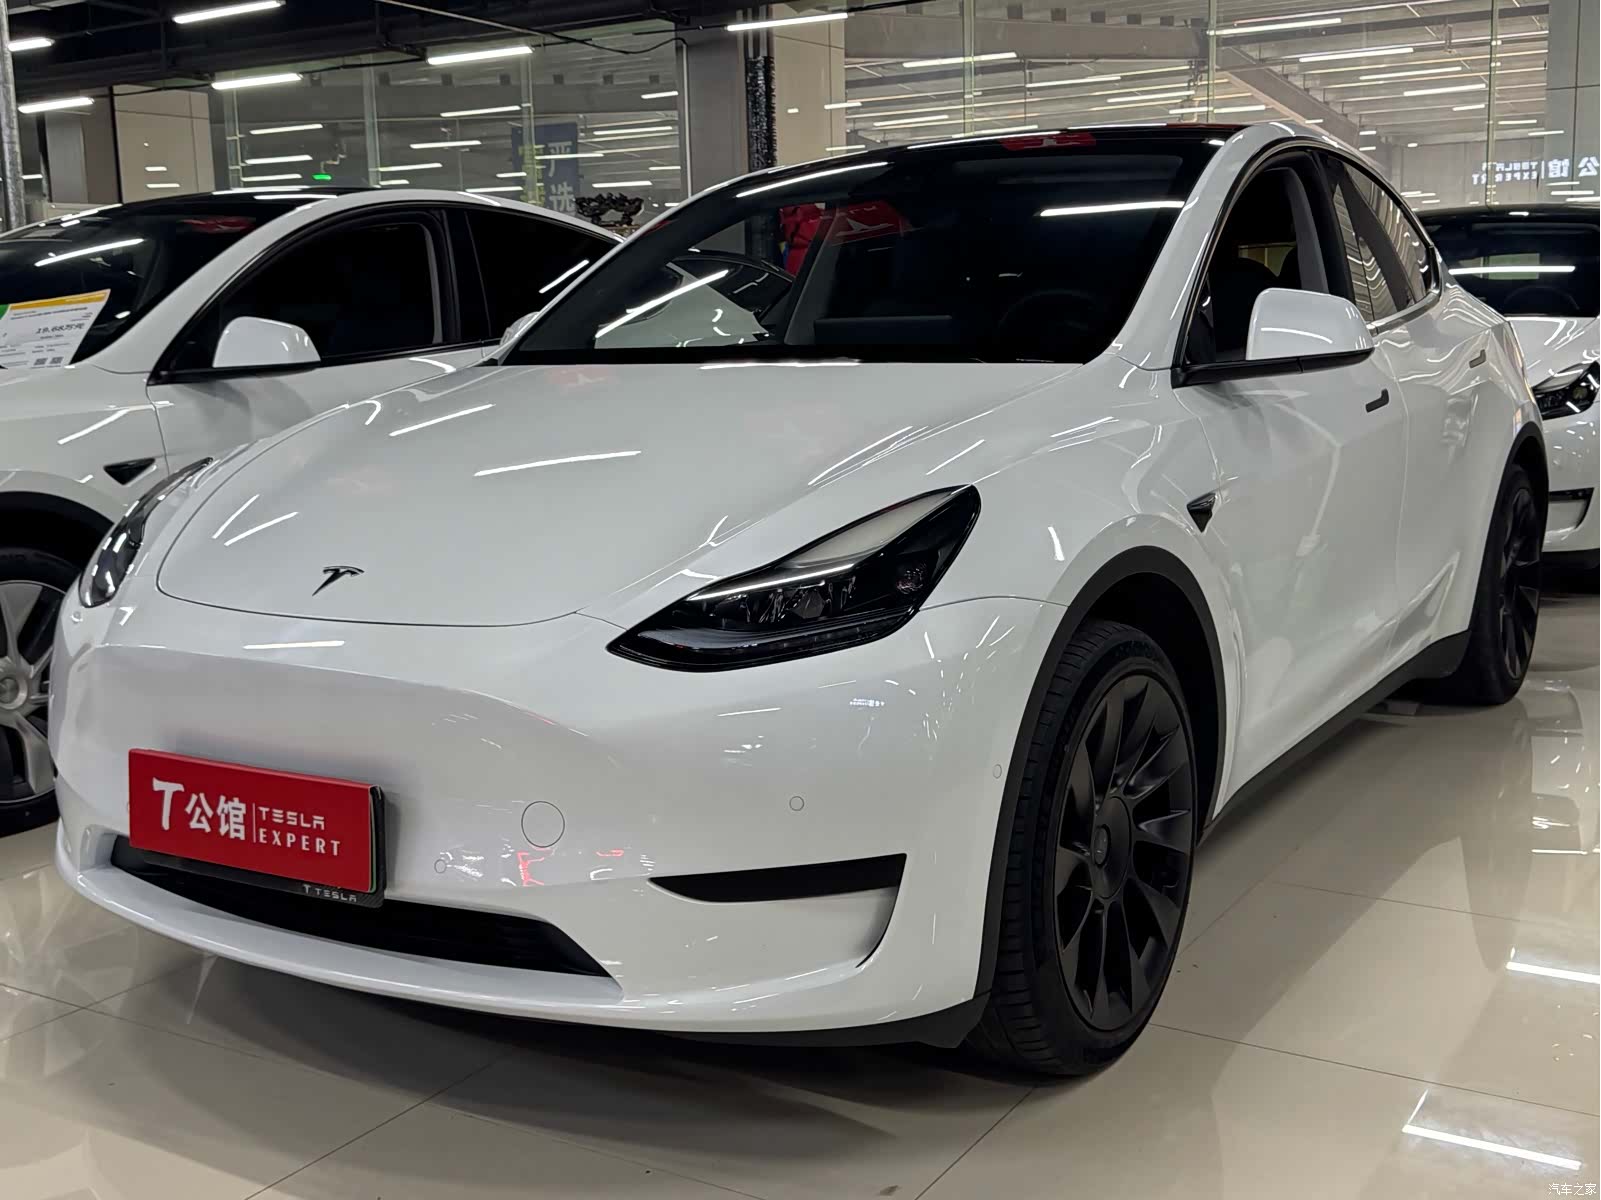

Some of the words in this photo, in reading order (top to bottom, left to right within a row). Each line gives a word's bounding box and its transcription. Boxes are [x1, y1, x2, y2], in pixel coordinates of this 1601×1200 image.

[258, 806, 326, 831] TESLA
[258, 827, 342, 857] EXPERT
[314, 887, 357, 903] TESLA
